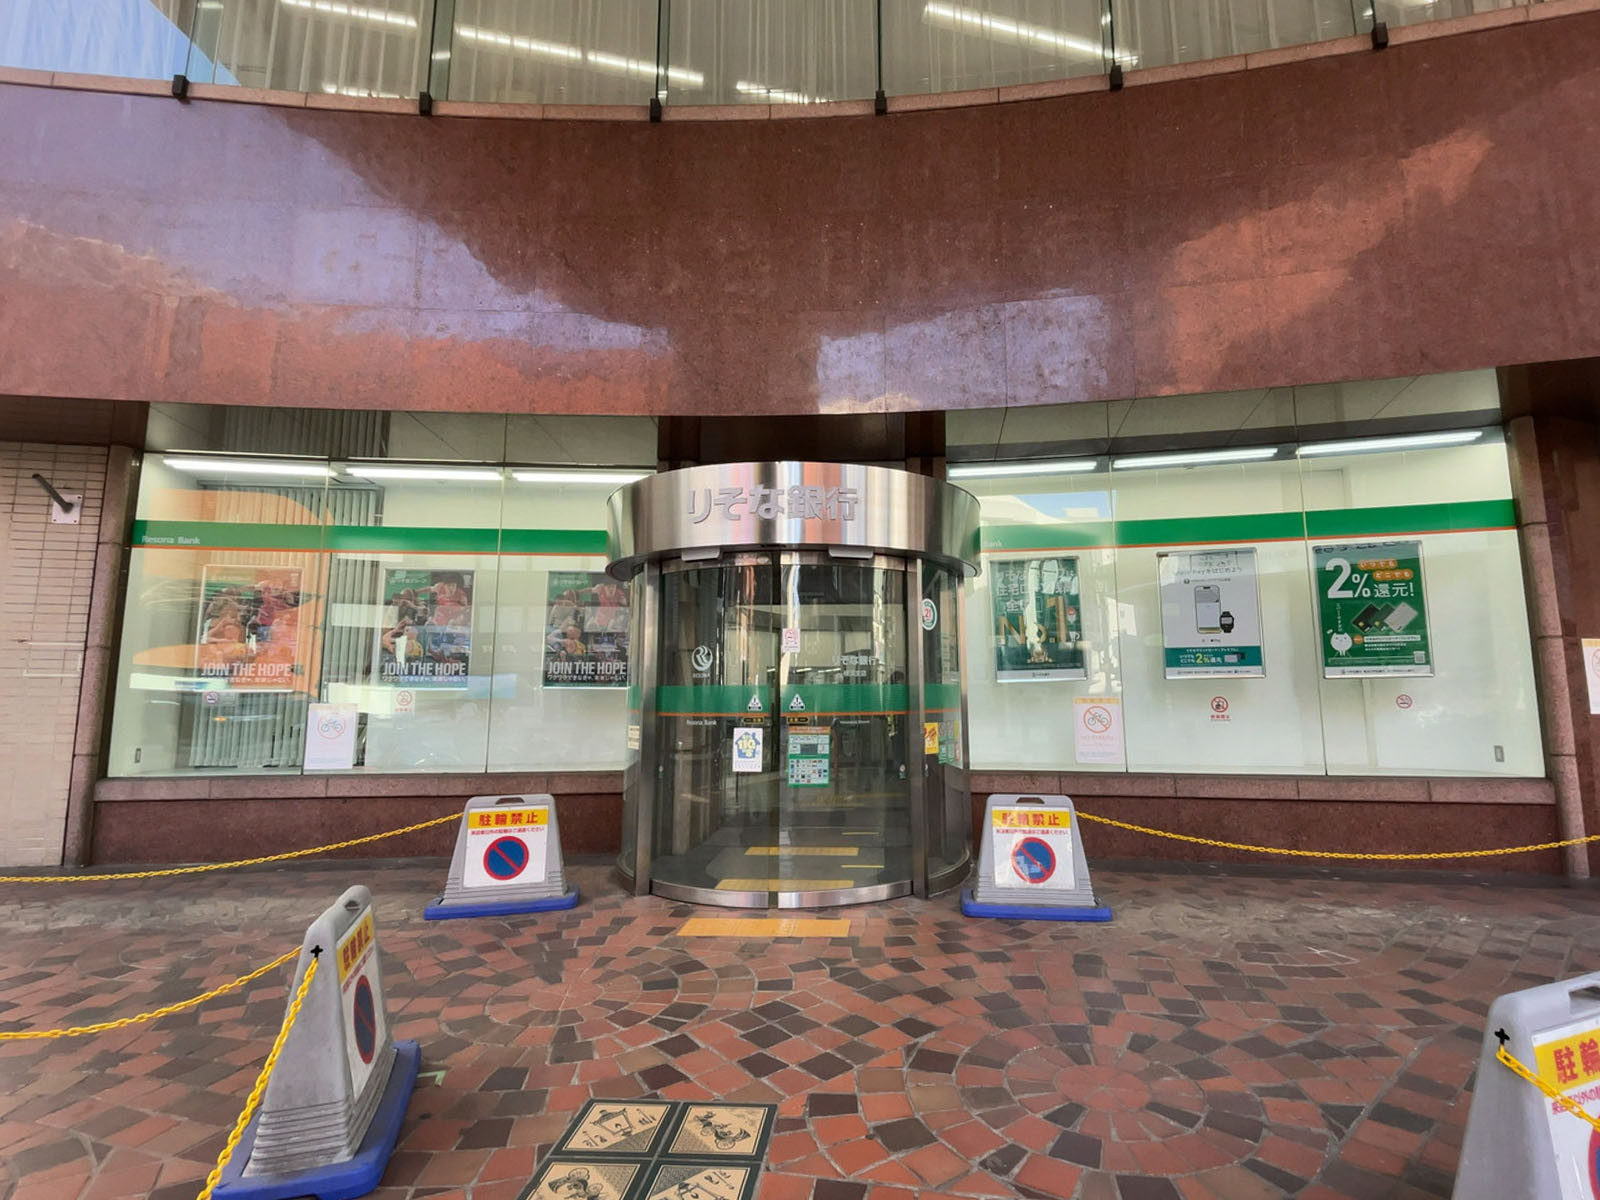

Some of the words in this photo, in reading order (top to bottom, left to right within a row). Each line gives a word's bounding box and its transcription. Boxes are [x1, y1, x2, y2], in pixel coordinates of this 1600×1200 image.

[687, 483, 858, 524] りそな銀行
[141, 535, 175, 544] Resona
[177, 535, 201, 544] Bank
[1325, 557, 1371, 598] 2%
[1374, 582, 1415, 597] 還元!
[200, 662, 230, 676] JOIN
[232, 662, 255, 676] THE
[257, 662, 292, 676] HOPE
[382, 662, 409, 676] JOIN
[411, 662, 433, 676] THE
[435, 662, 466, 676] HOPE
[548, 661, 572, 675] JOIN
[574, 661, 595, 675] THE
[597, 661, 626, 675] HOPE
[478, 812, 539, 826] 駐輪禁止
[1002, 812, 1060, 826] 駐輪禁止
